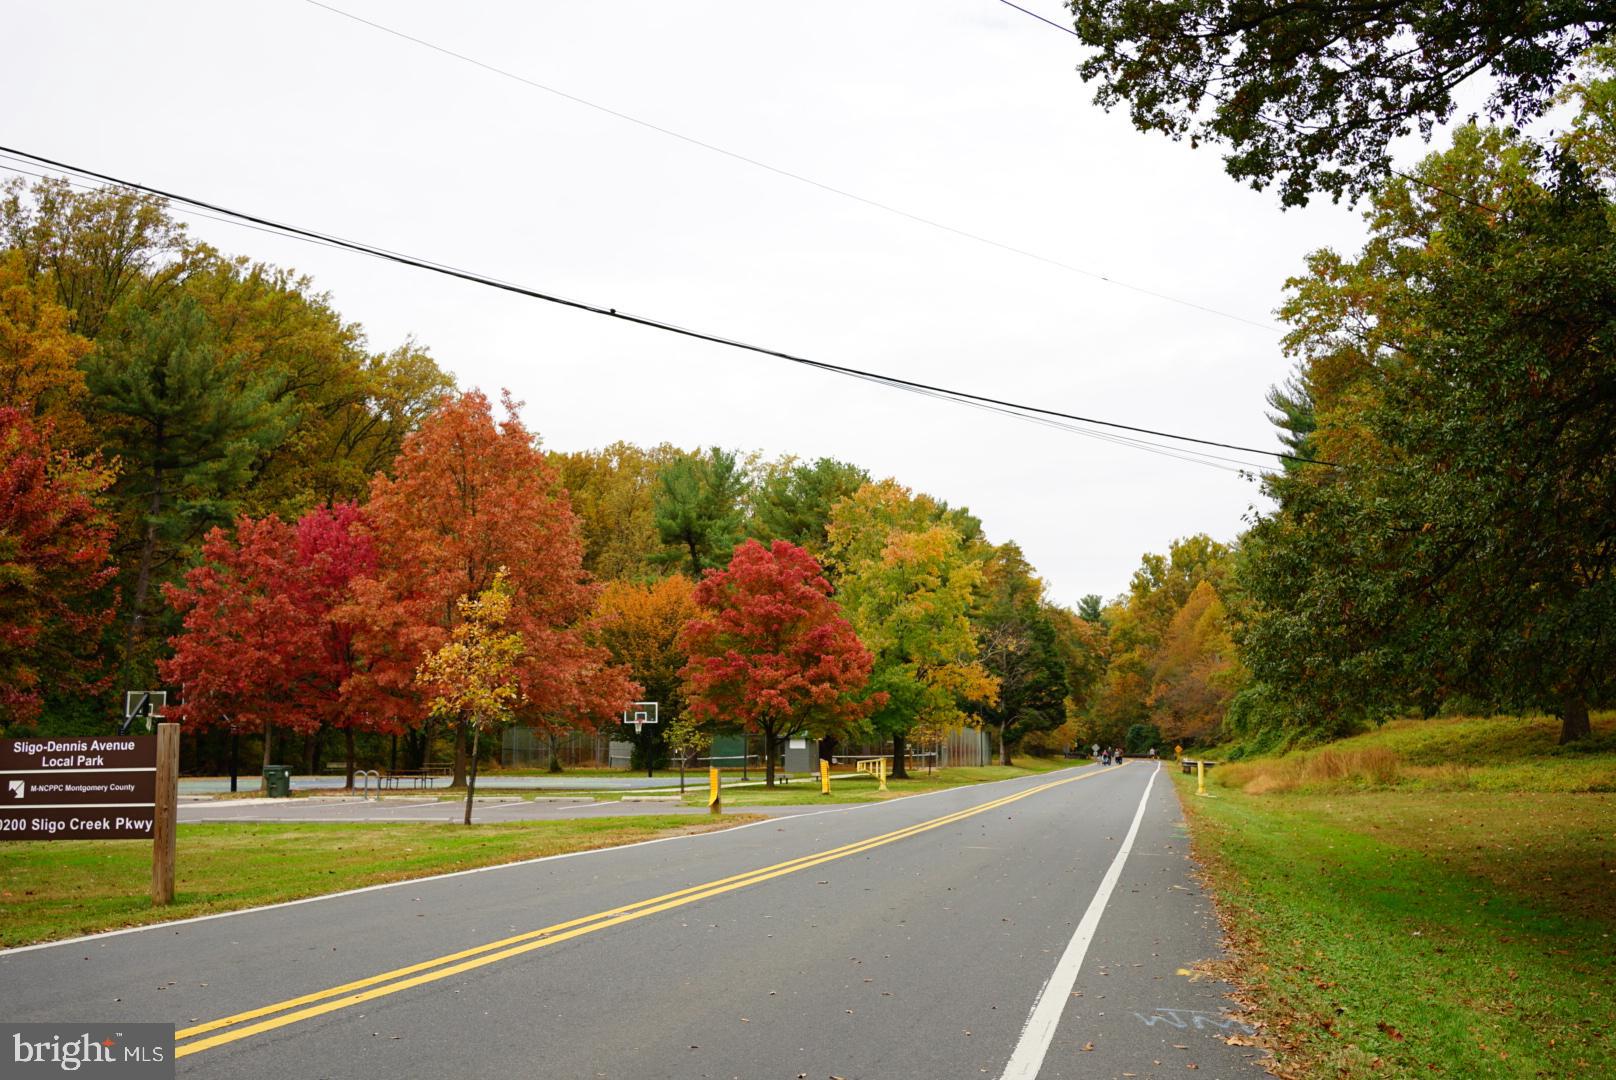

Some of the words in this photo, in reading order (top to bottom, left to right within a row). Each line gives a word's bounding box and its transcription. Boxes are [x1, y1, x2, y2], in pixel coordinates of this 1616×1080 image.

[14, 741, 88, 755] Sligo-Dennis
[90, 740, 135, 751] Avenue
[41, 755, 74, 768] Local
[77, 755, 104, 767] Park
[30, 784, 64, 793] M-NCPPC
[65, 783, 108, 793] Montgomery
[109, 783, 135, 792] County
[31, 818, 66, 833] Sligo
[69, 818, 110, 831] Creek
[115, 817, 153, 833] Pkwy
